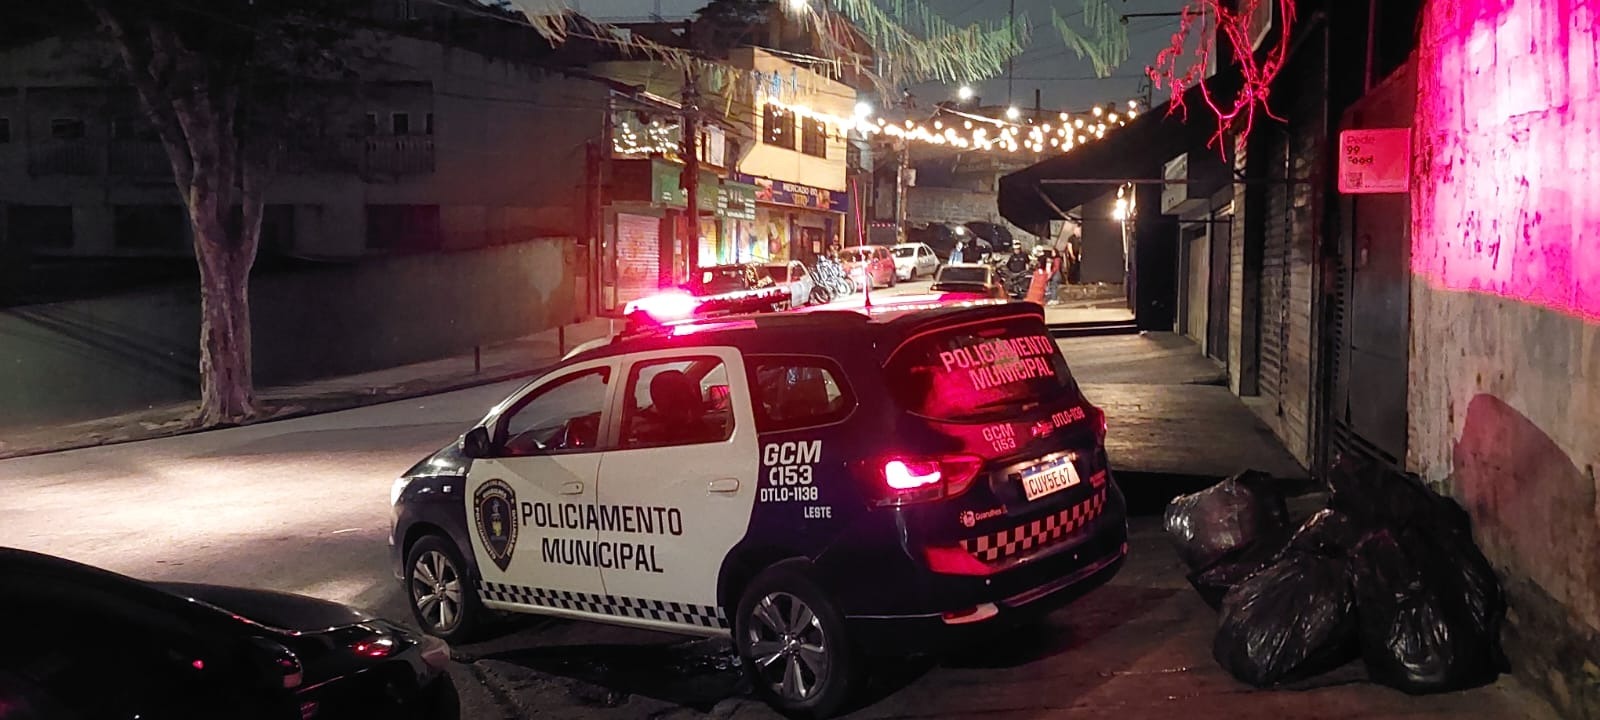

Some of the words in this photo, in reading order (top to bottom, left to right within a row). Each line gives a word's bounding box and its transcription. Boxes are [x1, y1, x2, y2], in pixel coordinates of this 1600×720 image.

[1346, 145, 1361, 155] 99
[940, 335, 1054, 373] POLICIAMENTO
[968, 357, 1055, 391] MUNICIPAL
[982, 423, 1016, 442] GCM
[763, 440, 822, 466] GCM
[760, 486, 818, 502] DTLO-1138
[1028, 467, 1072, 496] CUY5E67
[521, 502, 683, 536] POLICIAMENTO
[803, 506, 833, 519] LESTE
[542, 537, 664, 574] MUNICIPAL
